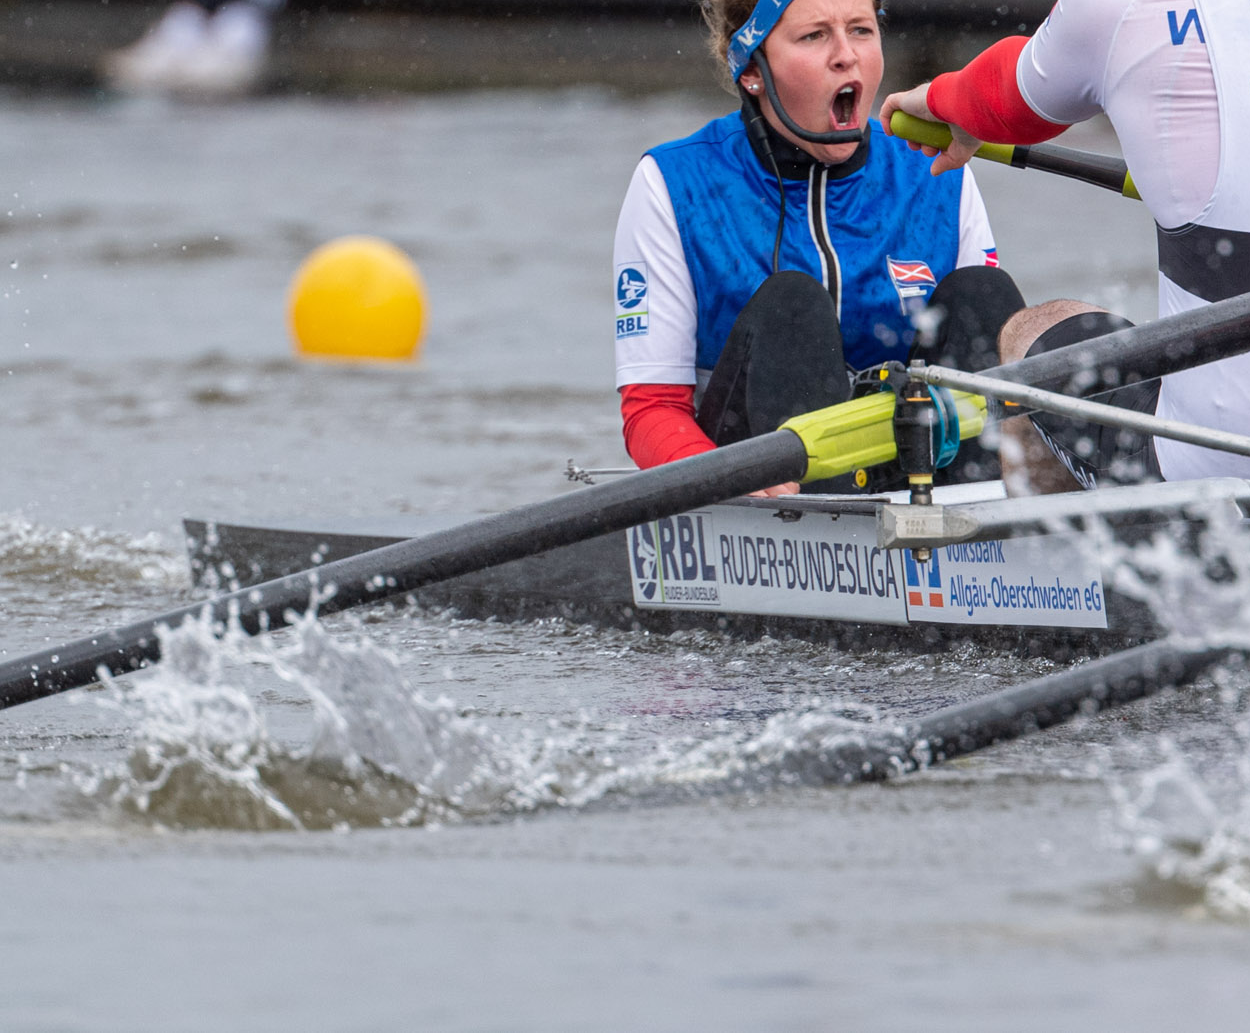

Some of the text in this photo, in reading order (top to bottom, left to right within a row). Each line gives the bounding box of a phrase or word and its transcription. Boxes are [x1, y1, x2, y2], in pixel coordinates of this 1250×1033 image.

[616, 316, 648, 335] RBL
[658, 515, 717, 581] RBL
[720, 534, 900, 599] RUDER-BUNDESLIGA
[950, 575, 1102, 617] Allgäu-Oberschwaben eG
